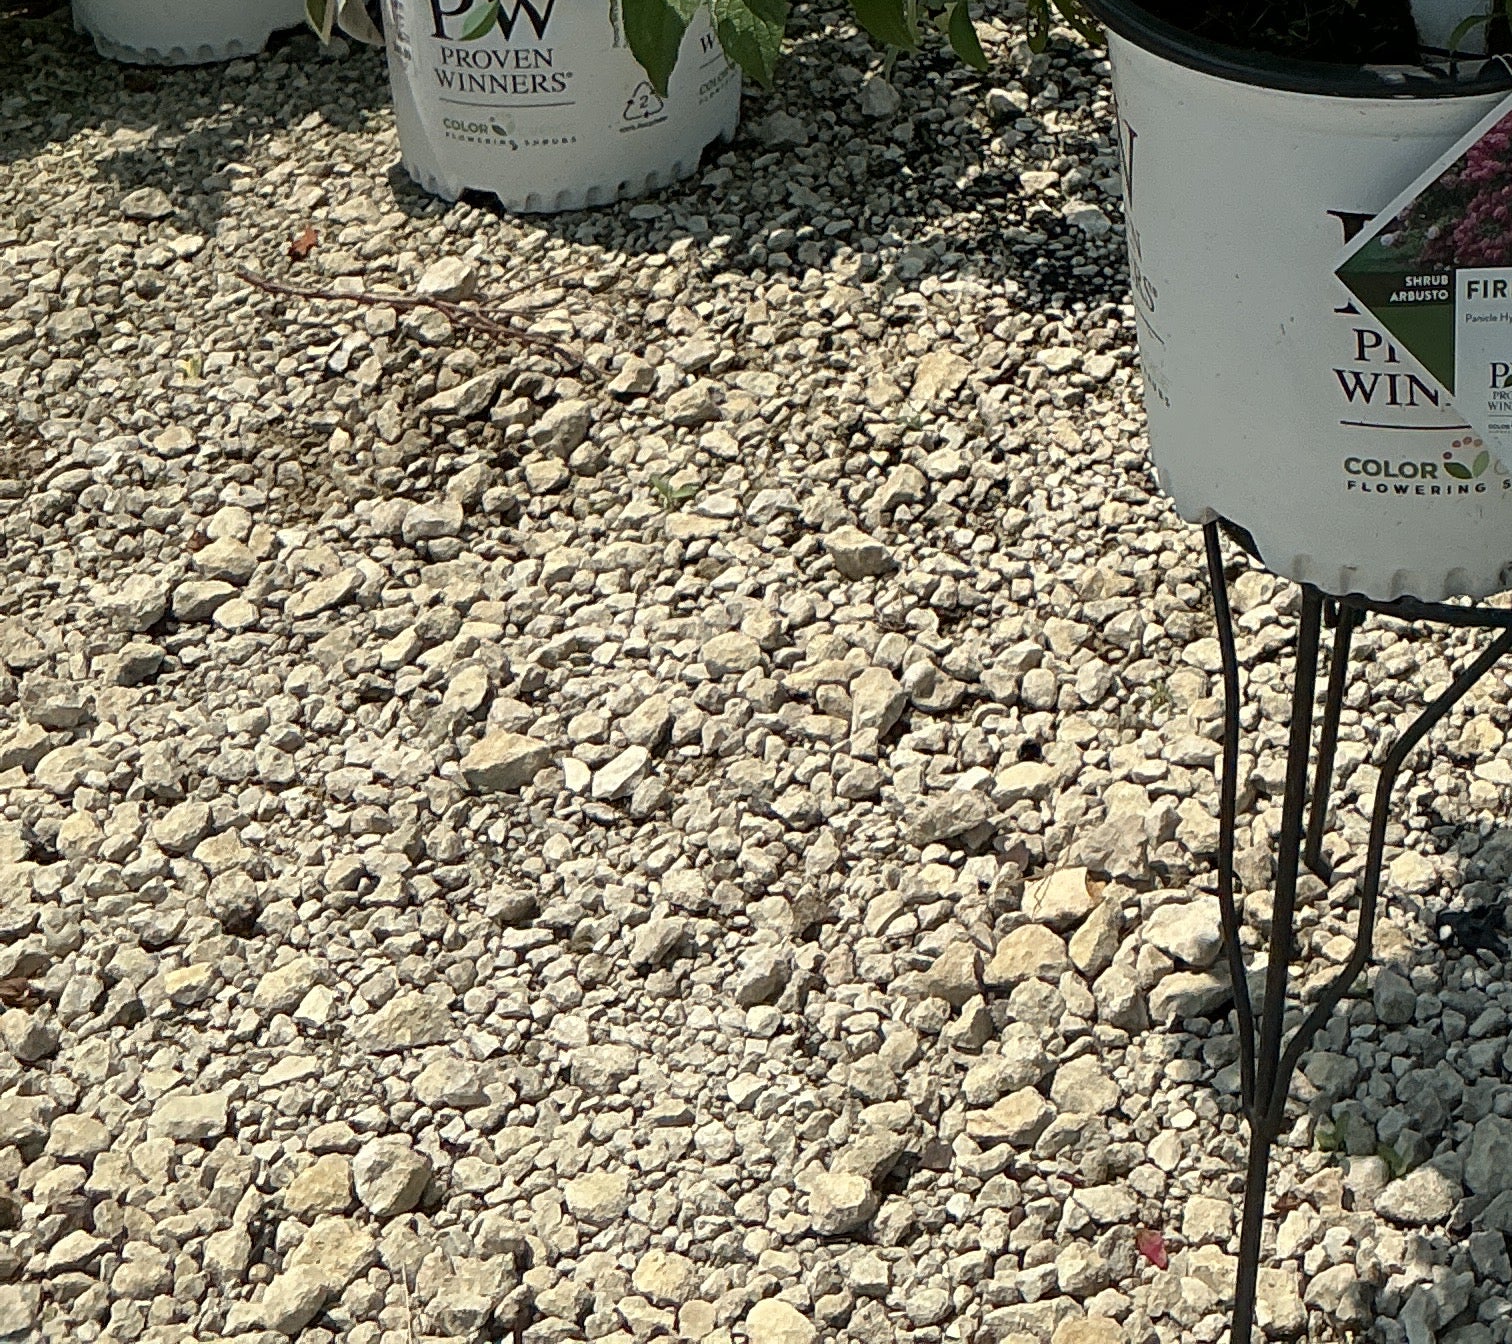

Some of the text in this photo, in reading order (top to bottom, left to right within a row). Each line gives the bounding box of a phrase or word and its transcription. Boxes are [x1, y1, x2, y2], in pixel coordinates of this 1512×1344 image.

[440, 45, 553, 70] PROVEN
[443, 117, 489, 135] COLOR
[1405, 274, 1449, 287] SHRUB
[1389, 289, 1449, 303] ARBUSTO
[1465, 313, 1498, 324] Panicle
[1344, 456, 1438, 479] COLOR
[1346, 479, 1487, 496] FLOWERING
